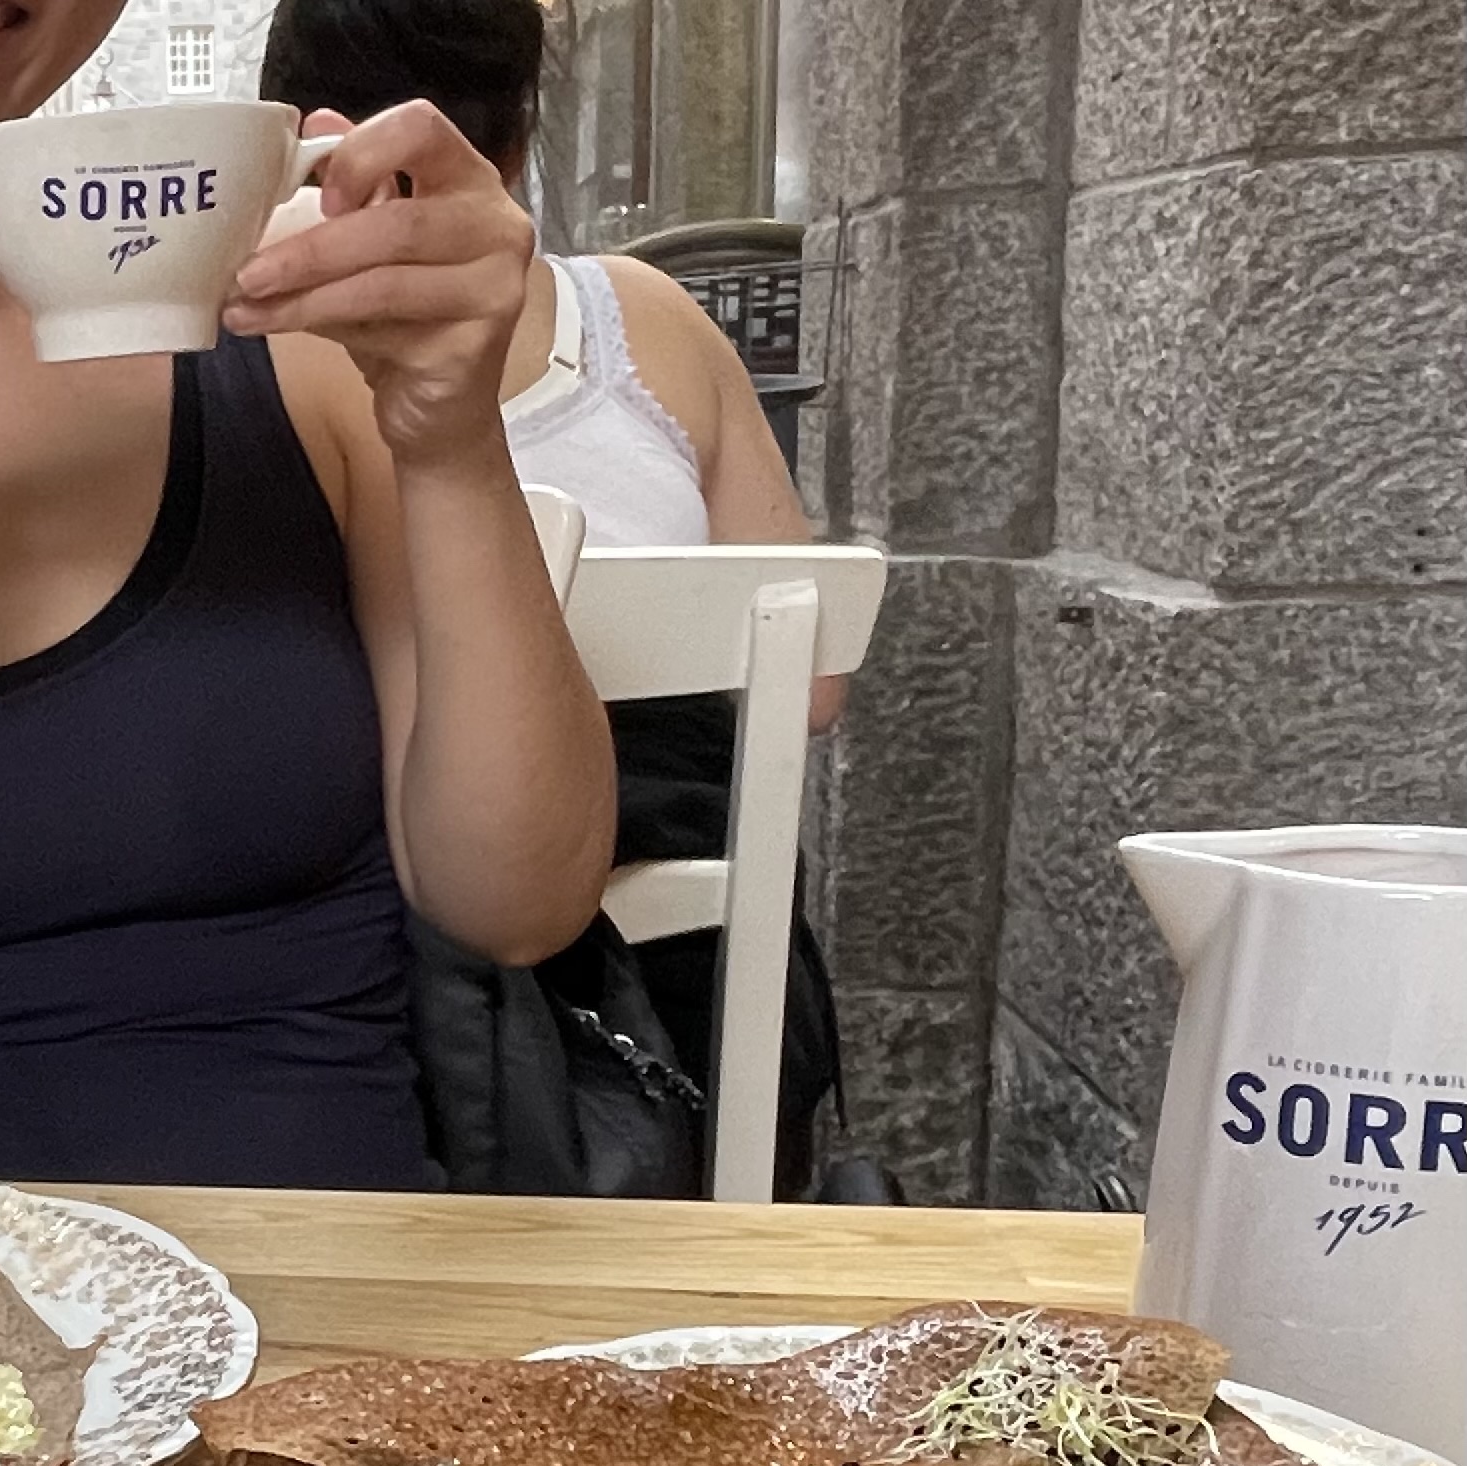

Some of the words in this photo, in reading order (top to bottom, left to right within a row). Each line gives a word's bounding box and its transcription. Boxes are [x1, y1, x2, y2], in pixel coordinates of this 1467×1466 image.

[41, 169, 218, 221] SORRE
[1267, 1053, 1286, 1069] LA
[1292, 1058, 1393, 1084] CIDRERIE
[1329, 1174, 1401, 1195] DEPUIS
[1314, 1201, 1427, 1257] 1952
